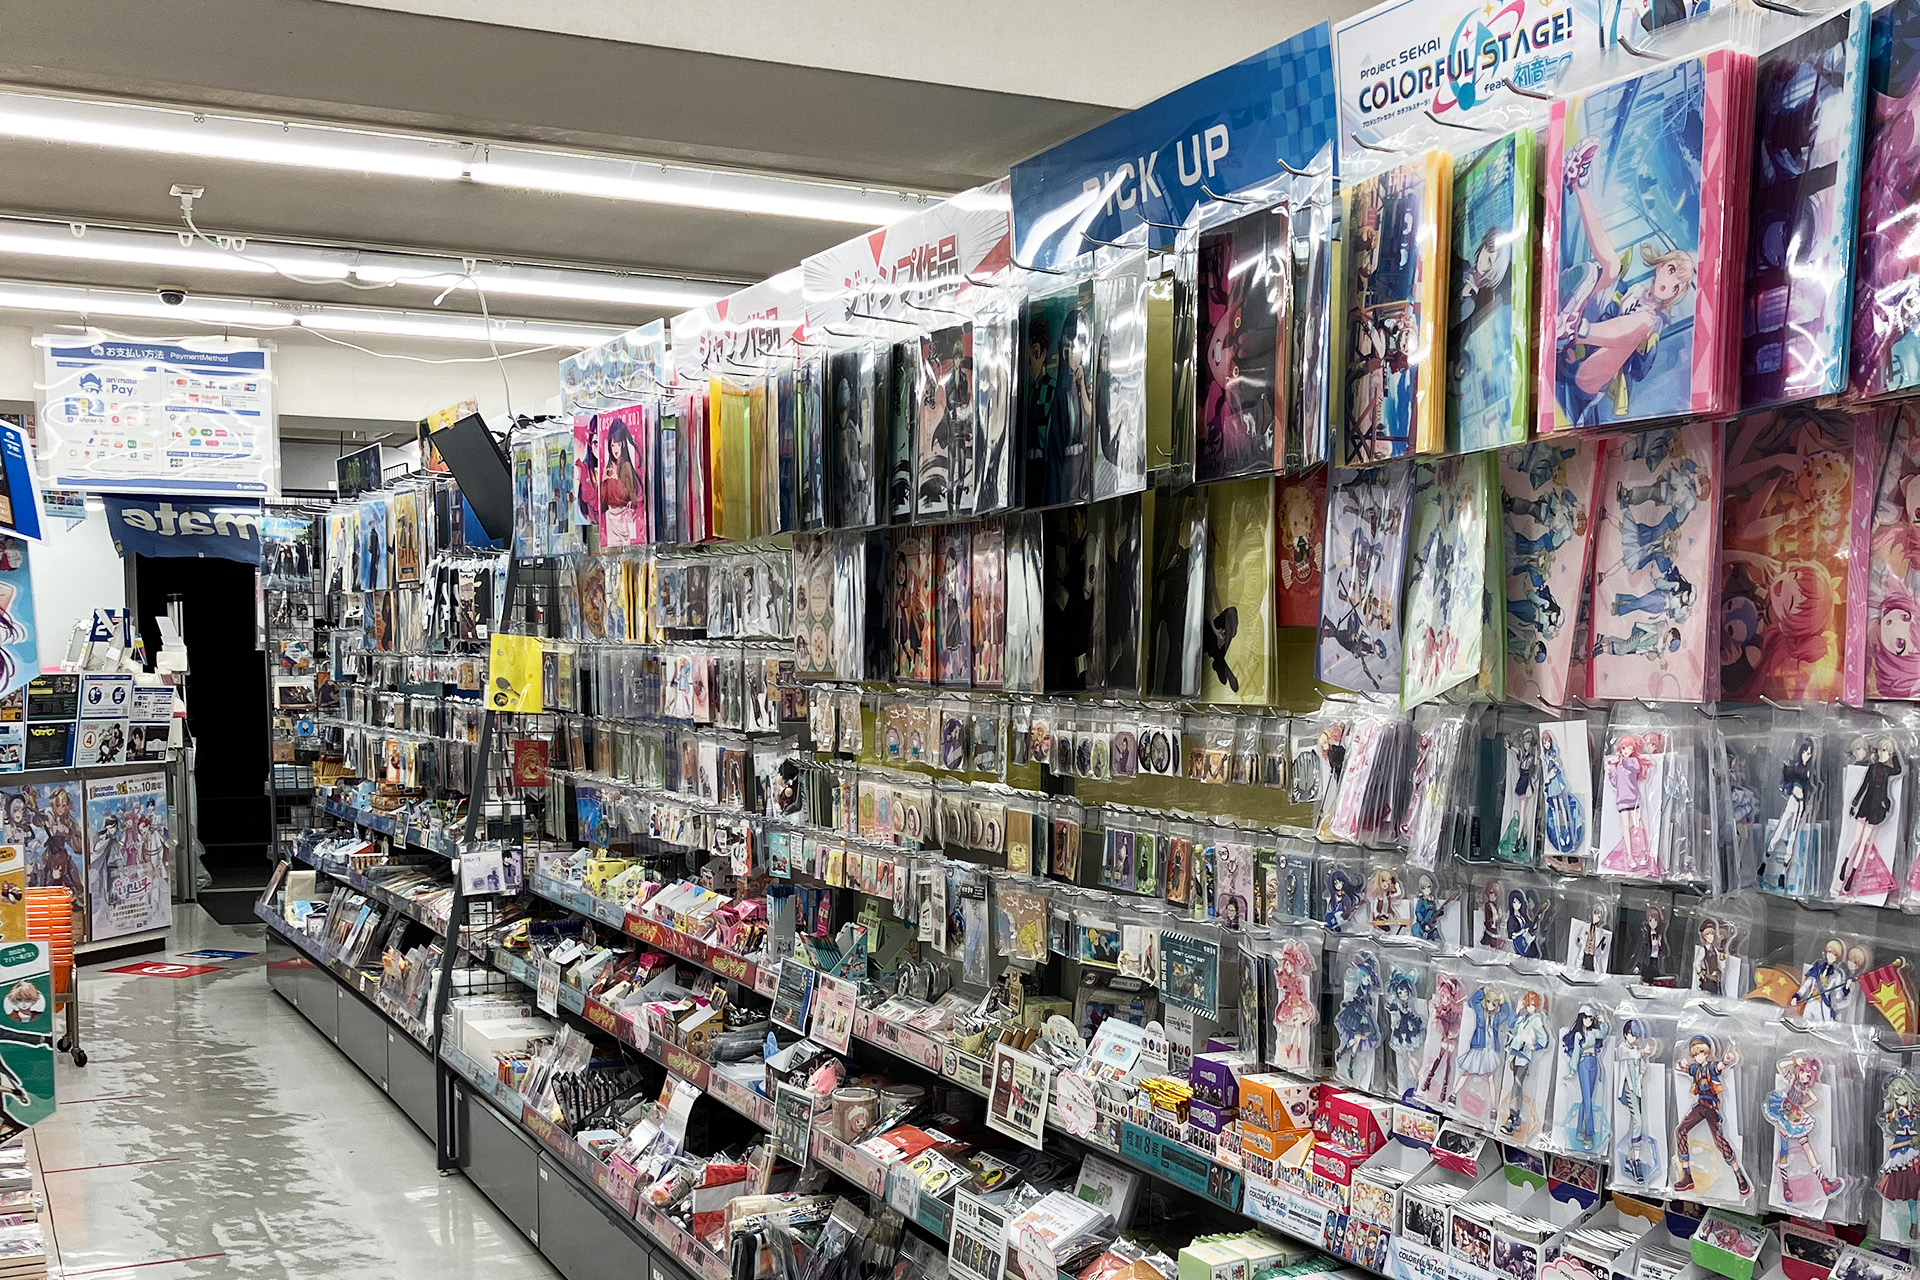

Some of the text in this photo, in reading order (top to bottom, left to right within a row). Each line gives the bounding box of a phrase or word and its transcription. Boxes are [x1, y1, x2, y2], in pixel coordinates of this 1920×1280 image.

[1358, 7, 1573, 114] COLORFUL STAGE!
[1360, 36, 1441, 80] Project SEKAI
[1175, 122, 1230, 187] UP
[105, 346, 229, 364] お支払い方法 PaymentMethod
[105, 375, 138, 385] animate
[111, 384, 134, 397] Pay
